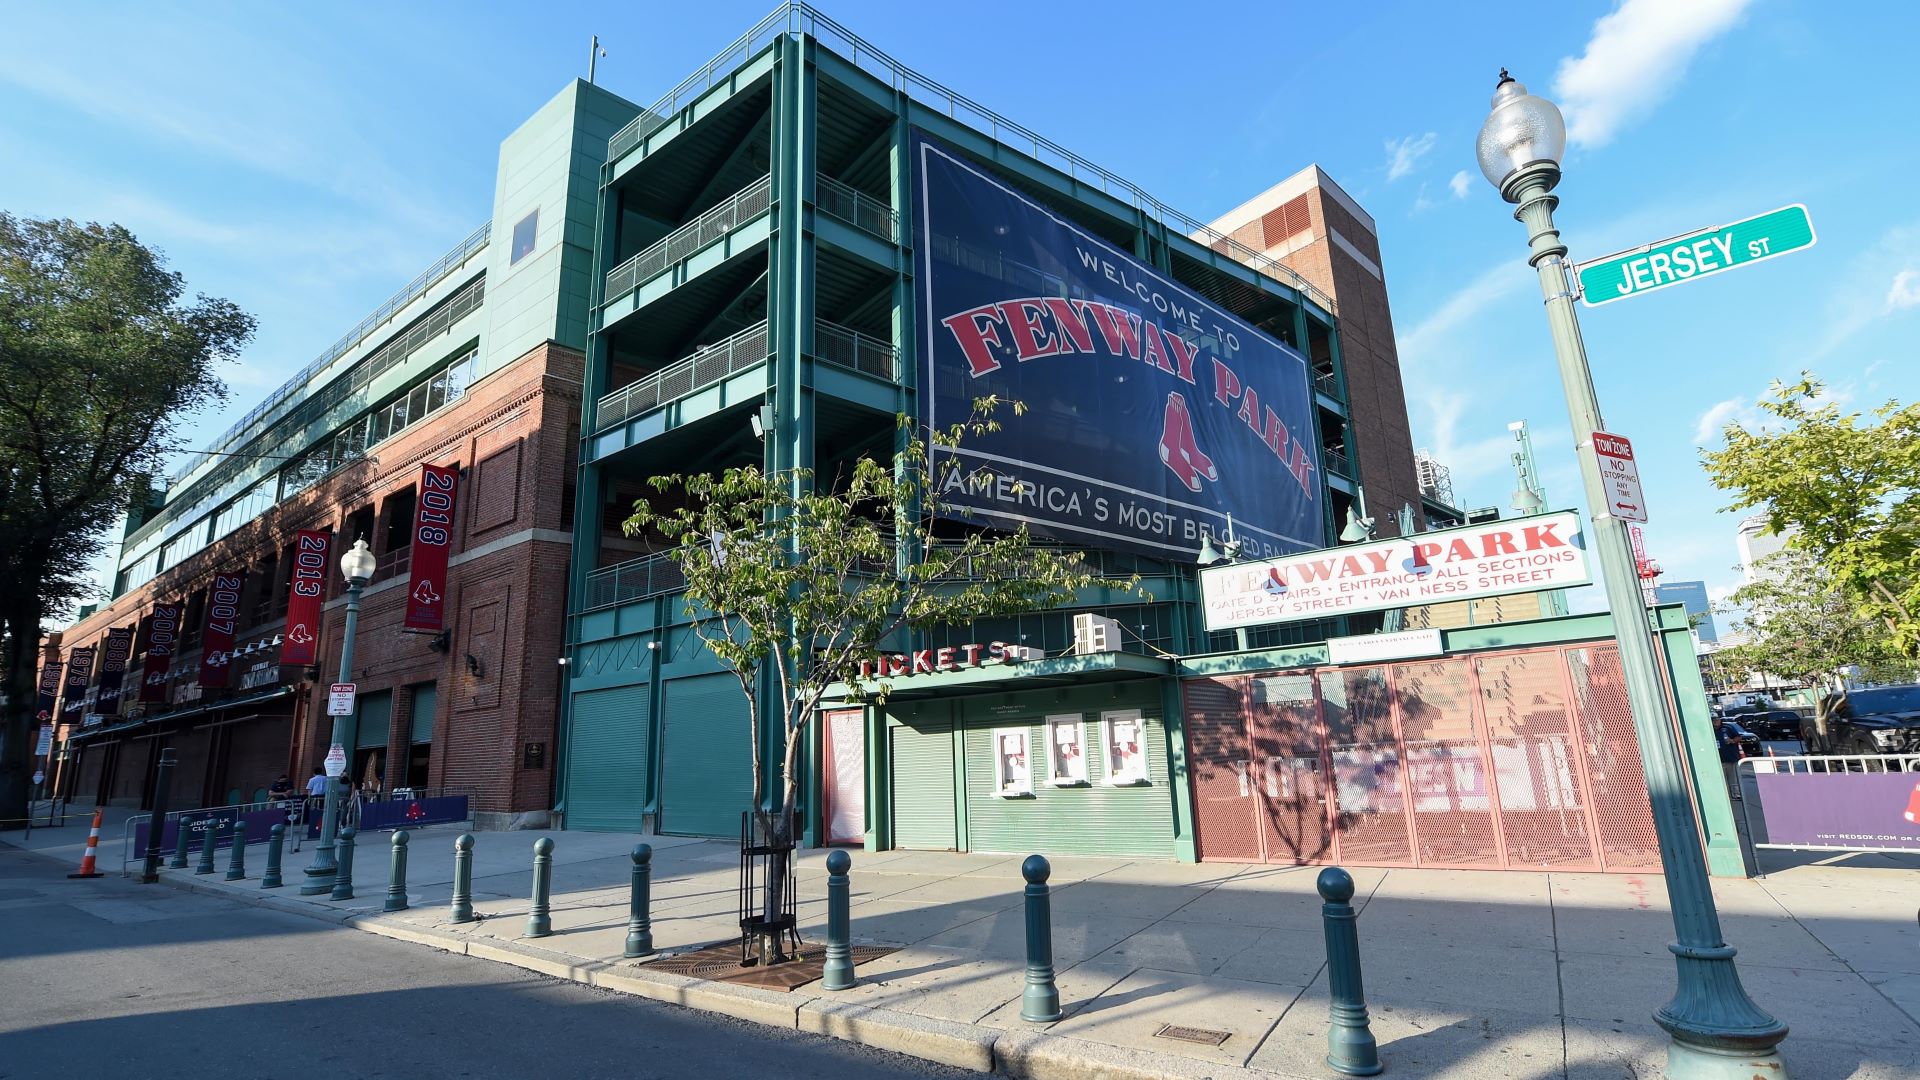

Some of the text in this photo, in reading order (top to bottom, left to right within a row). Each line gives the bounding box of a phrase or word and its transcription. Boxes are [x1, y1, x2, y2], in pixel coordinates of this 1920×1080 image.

[1616, 232, 1770, 295] JERSEY ST
[1076, 247, 1240, 351] WELCOME TO
[941, 297, 1314, 501] FENWAY PARK
[1596, 438, 1631, 457] TOW ZONE
[1610, 459, 1625, 472] NO
[1604, 470, 1636, 483] STOPPING
[1616, 482, 1628, 490] ANY
[1617, 489, 1631, 498] TIME
[419, 470, 454, 545] 2018
[943, 467, 1109, 522] AMERICA'S
[1118, 501, 1177, 536] MOST
[295, 535, 326, 597] 2013
[1411, 523, 1567, 568] PARK
[1226, 568, 1555, 621] JERSEY STREET VAN NESS STREET
[1269, 586, 1321, 602] STAIRS
[1339, 571, 1427, 593] ENTRANCE
[1436, 566, 1470, 579] ALL
[1477, 550, 1575, 574] SECTIONS
[210, 576, 241, 635] 2007
[104, 631, 130, 672] 1986
[149, 606, 177, 657] 2004
[69, 650, 92, 686] 1975
[859, 640, 1012, 679] TICKETS
[40, 664, 62, 697] 1967
[189, 817, 230, 827] SIDELK
[192, 823, 225, 832] CLOD
[1839, 833, 1897, 841] REDSOX.COM
